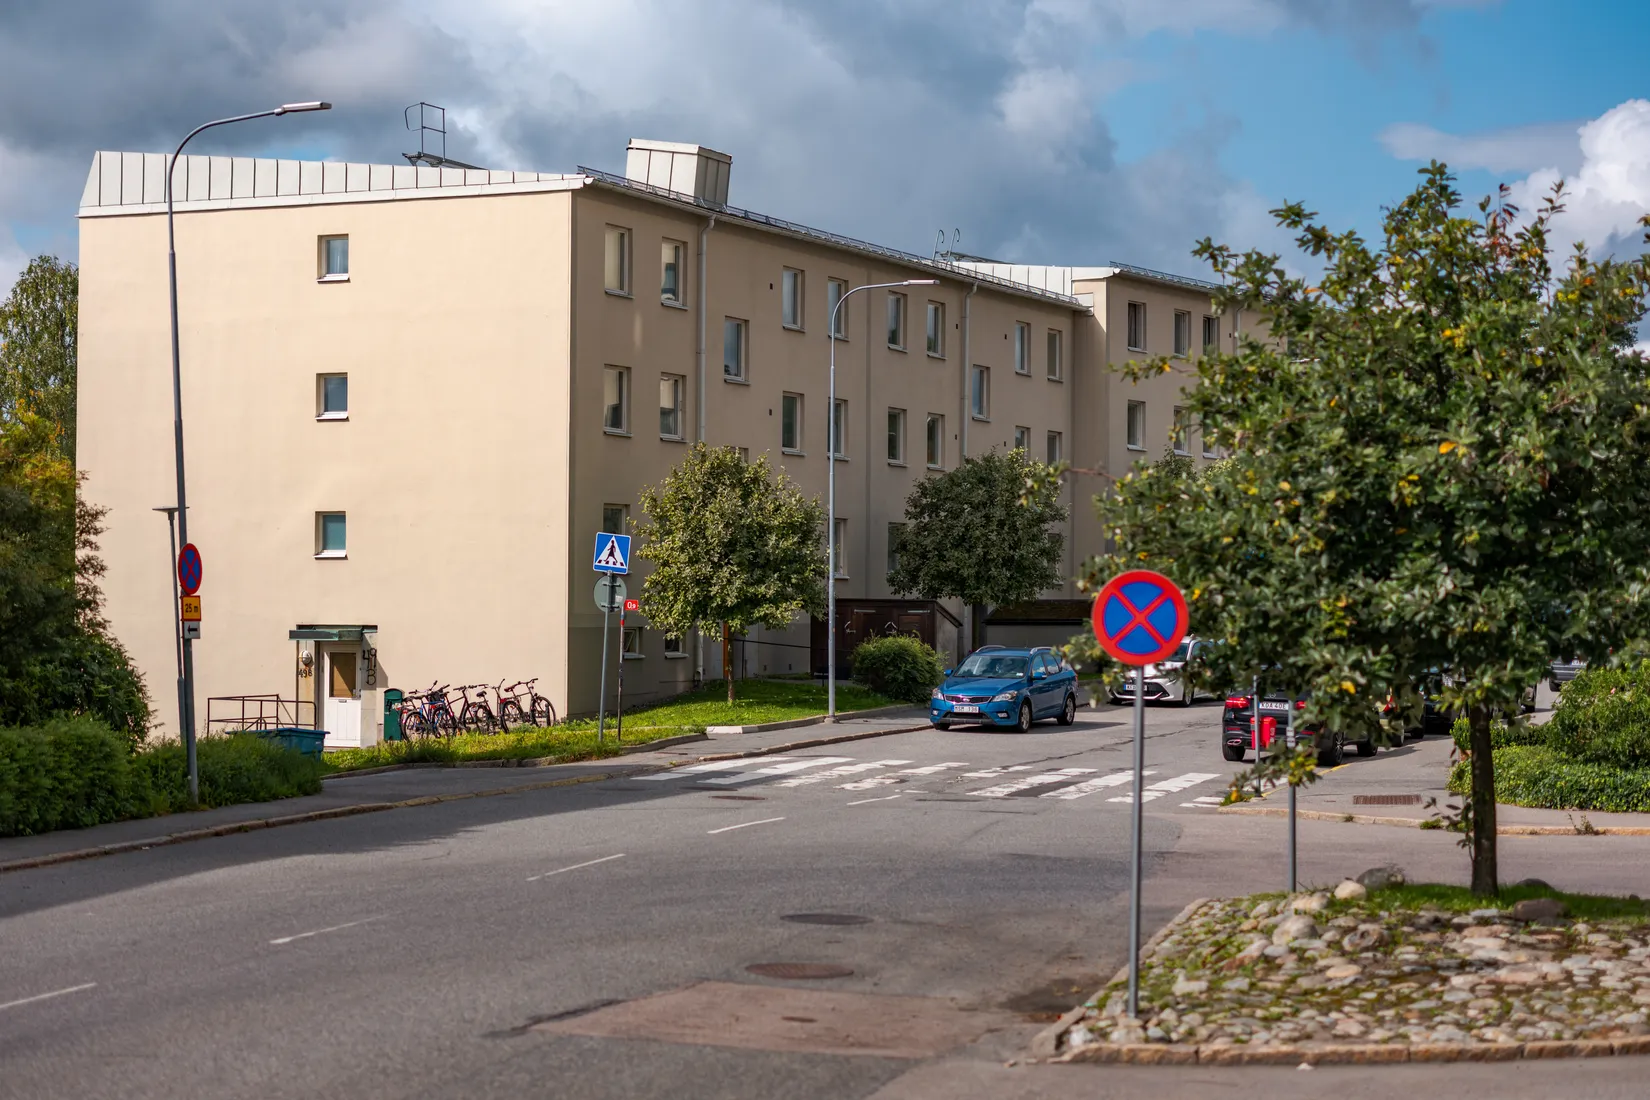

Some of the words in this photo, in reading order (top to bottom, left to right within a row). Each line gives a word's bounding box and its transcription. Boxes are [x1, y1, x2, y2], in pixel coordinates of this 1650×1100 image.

[185, 603, 192, 613] 25
[194, 605, 199, 613] m
[362, 647, 377, 670] 49
